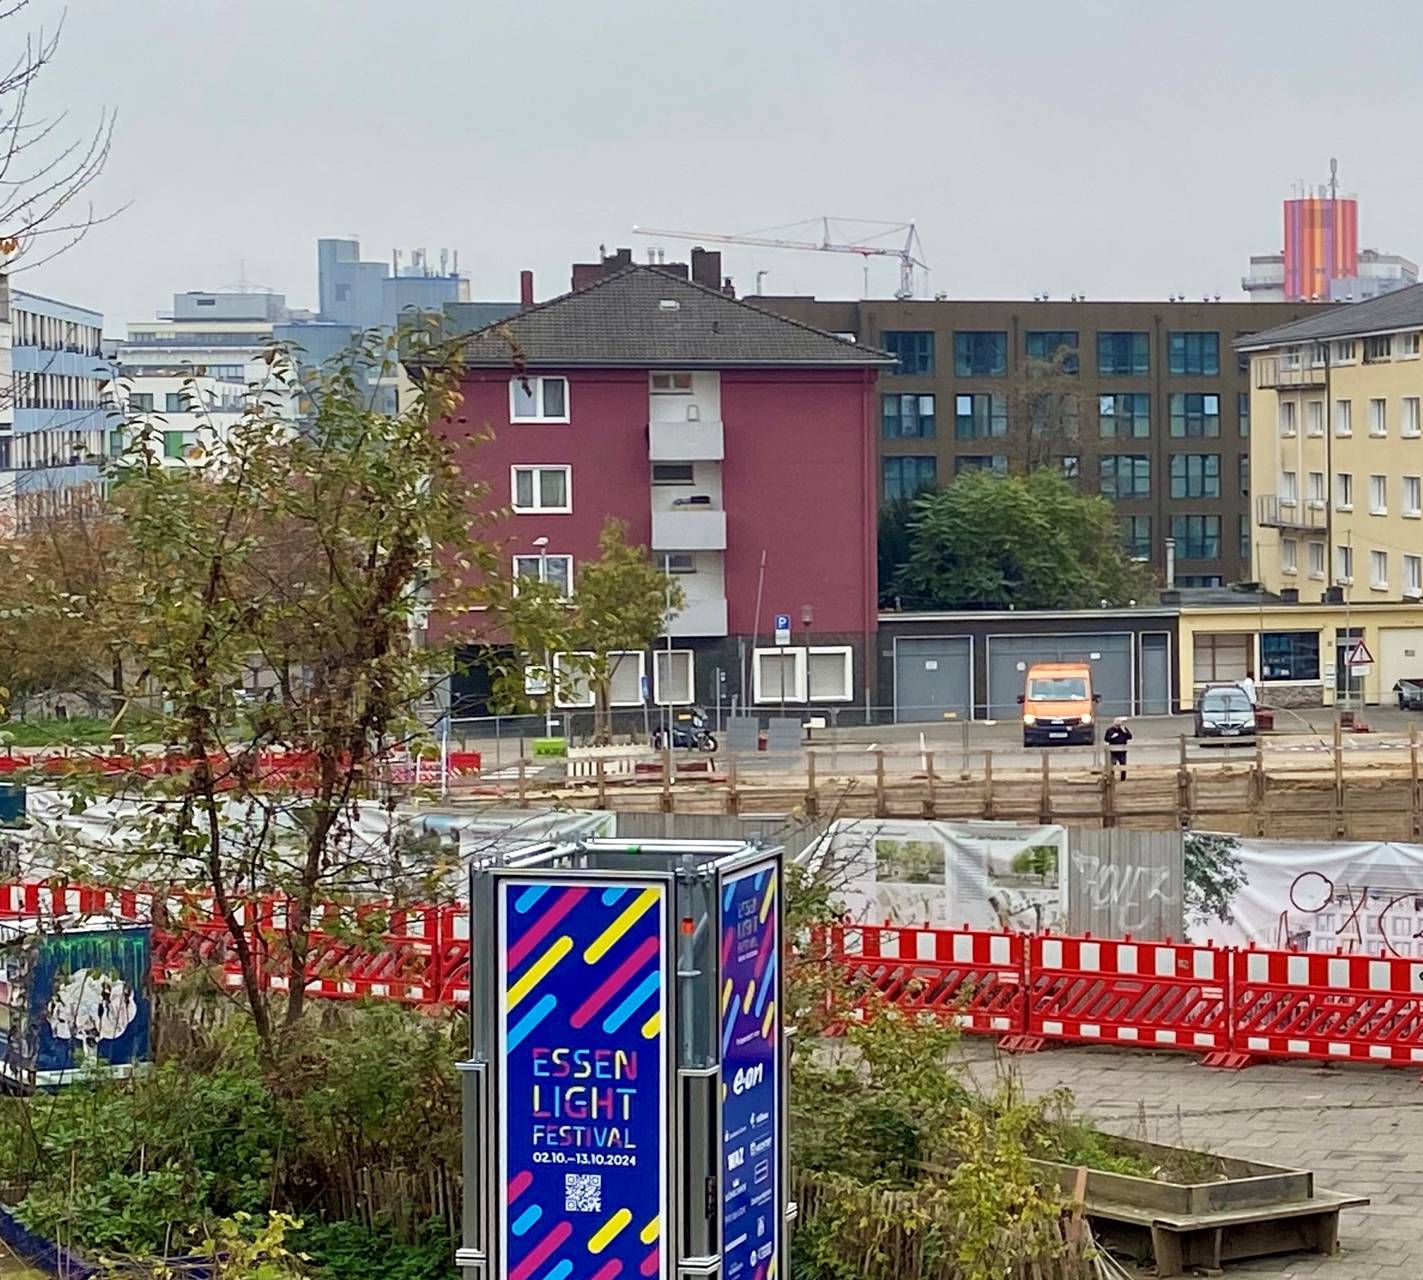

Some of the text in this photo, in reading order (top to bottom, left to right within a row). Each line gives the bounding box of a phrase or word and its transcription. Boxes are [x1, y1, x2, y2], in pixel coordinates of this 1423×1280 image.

[533, 1048, 637, 1080] ESSEN
[533, 1085, 637, 1120] LIGHT
[533, 1125, 637, 1149] FESTIVAL
